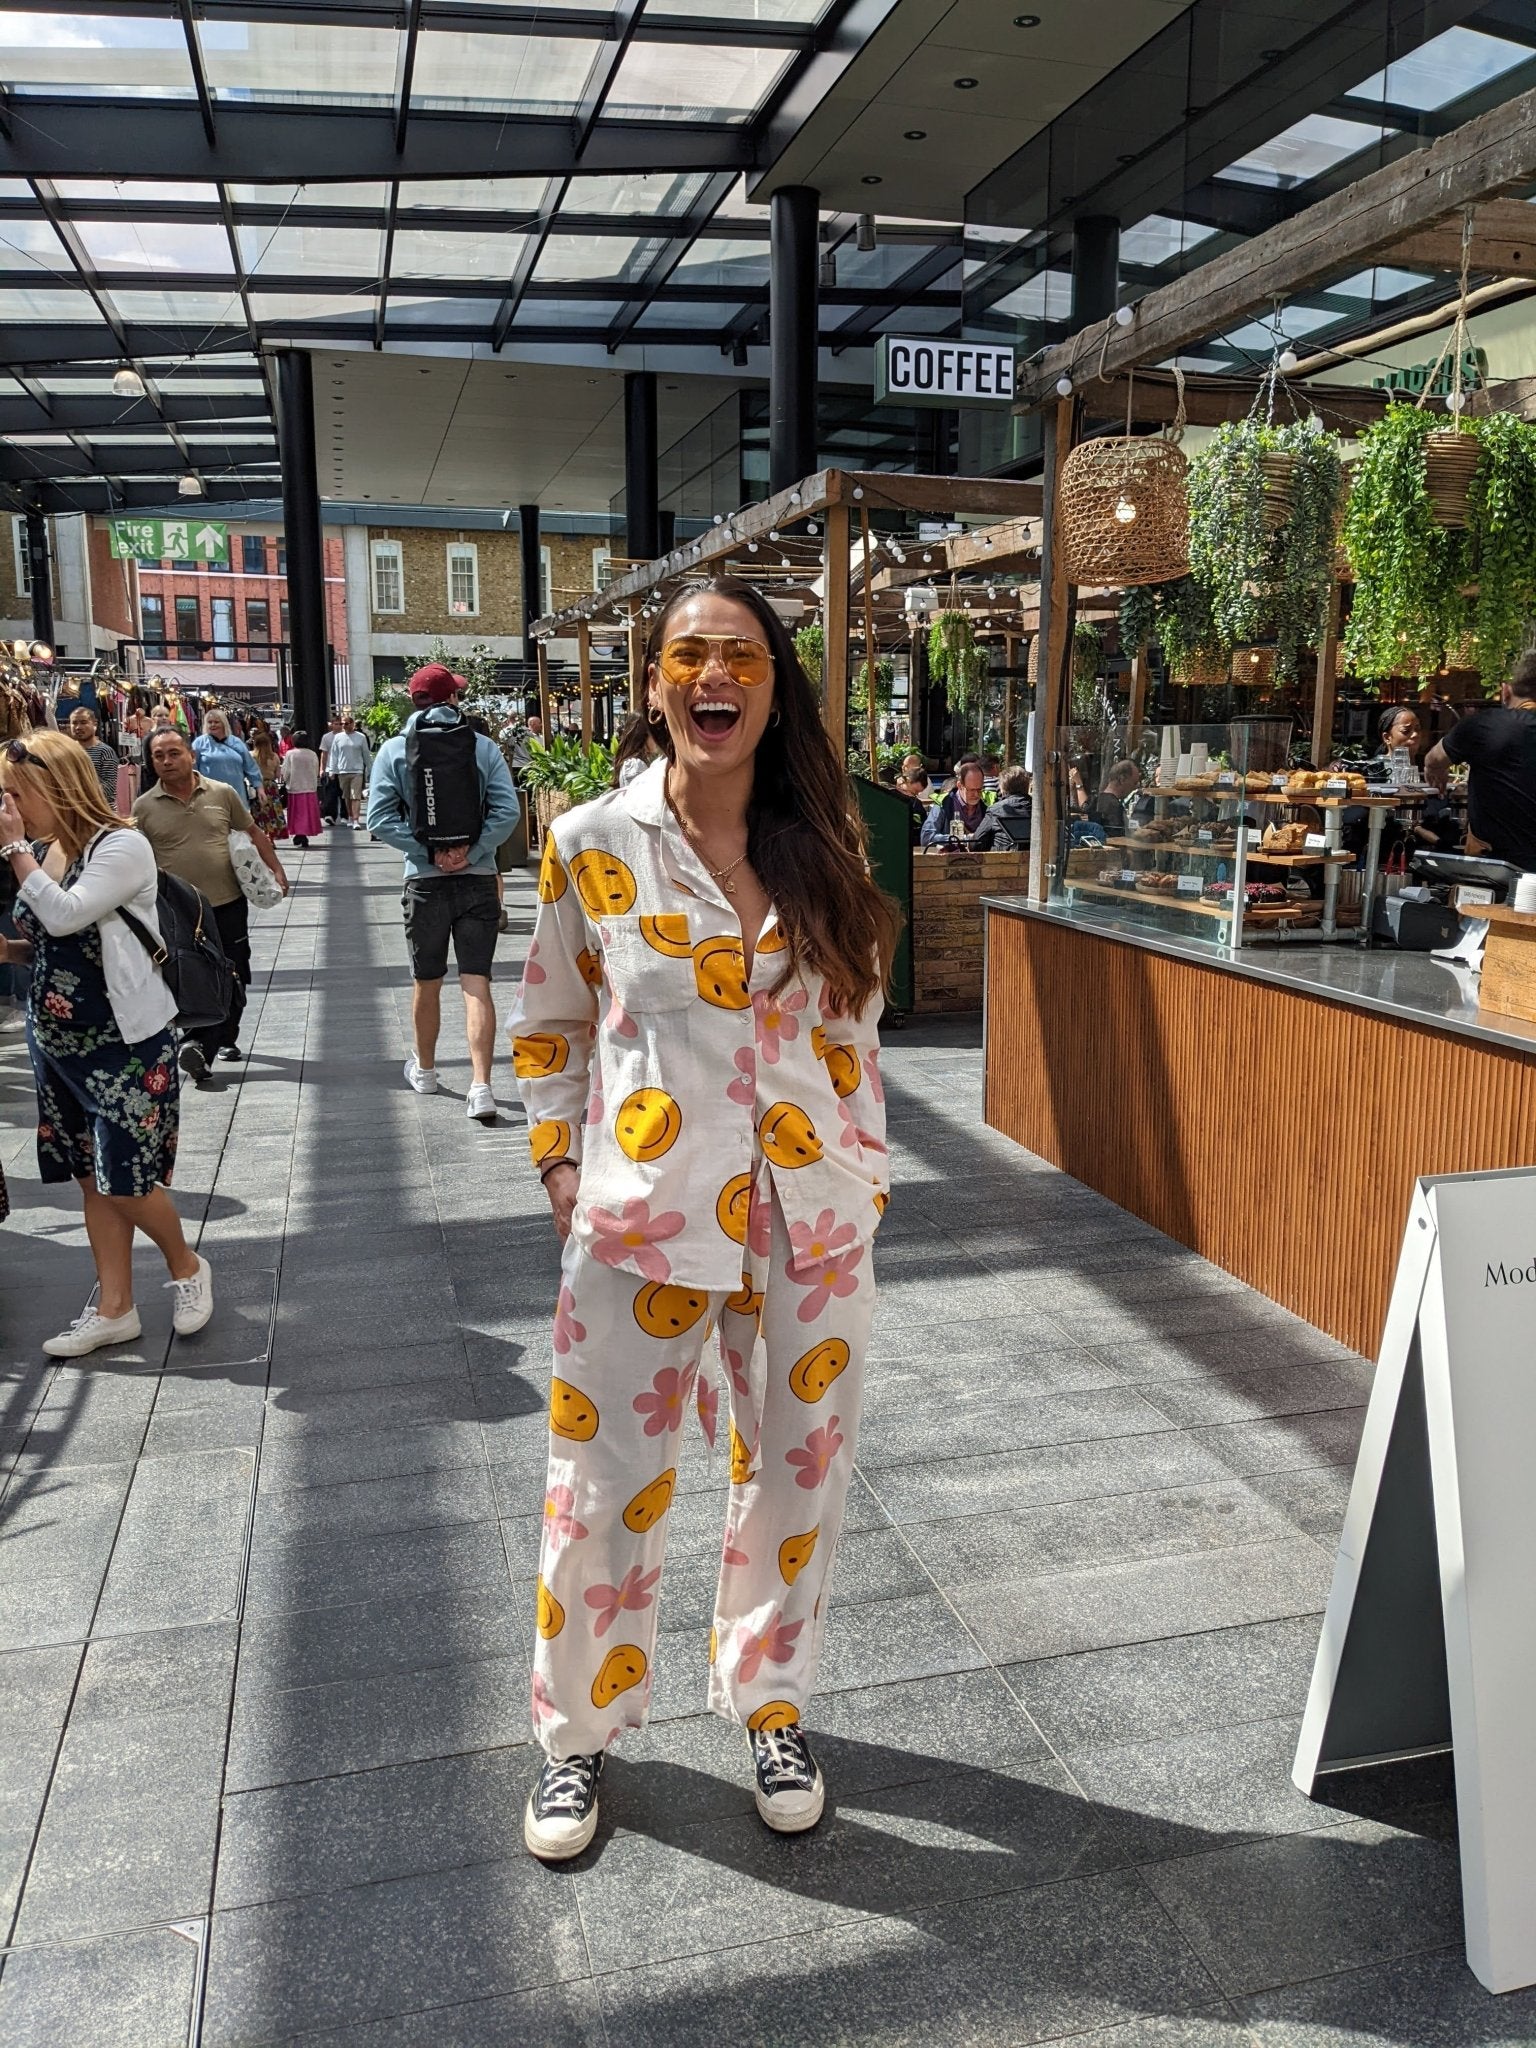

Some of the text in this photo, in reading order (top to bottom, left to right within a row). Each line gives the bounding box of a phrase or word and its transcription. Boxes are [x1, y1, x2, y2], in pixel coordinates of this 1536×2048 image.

[891, 346, 1012, 395] COFFEE
[115, 521, 154, 538] Fire
[118, 539, 155, 555] exit
[227, 691, 251, 700] GUN
[424, 768, 436, 826] SKORCH
